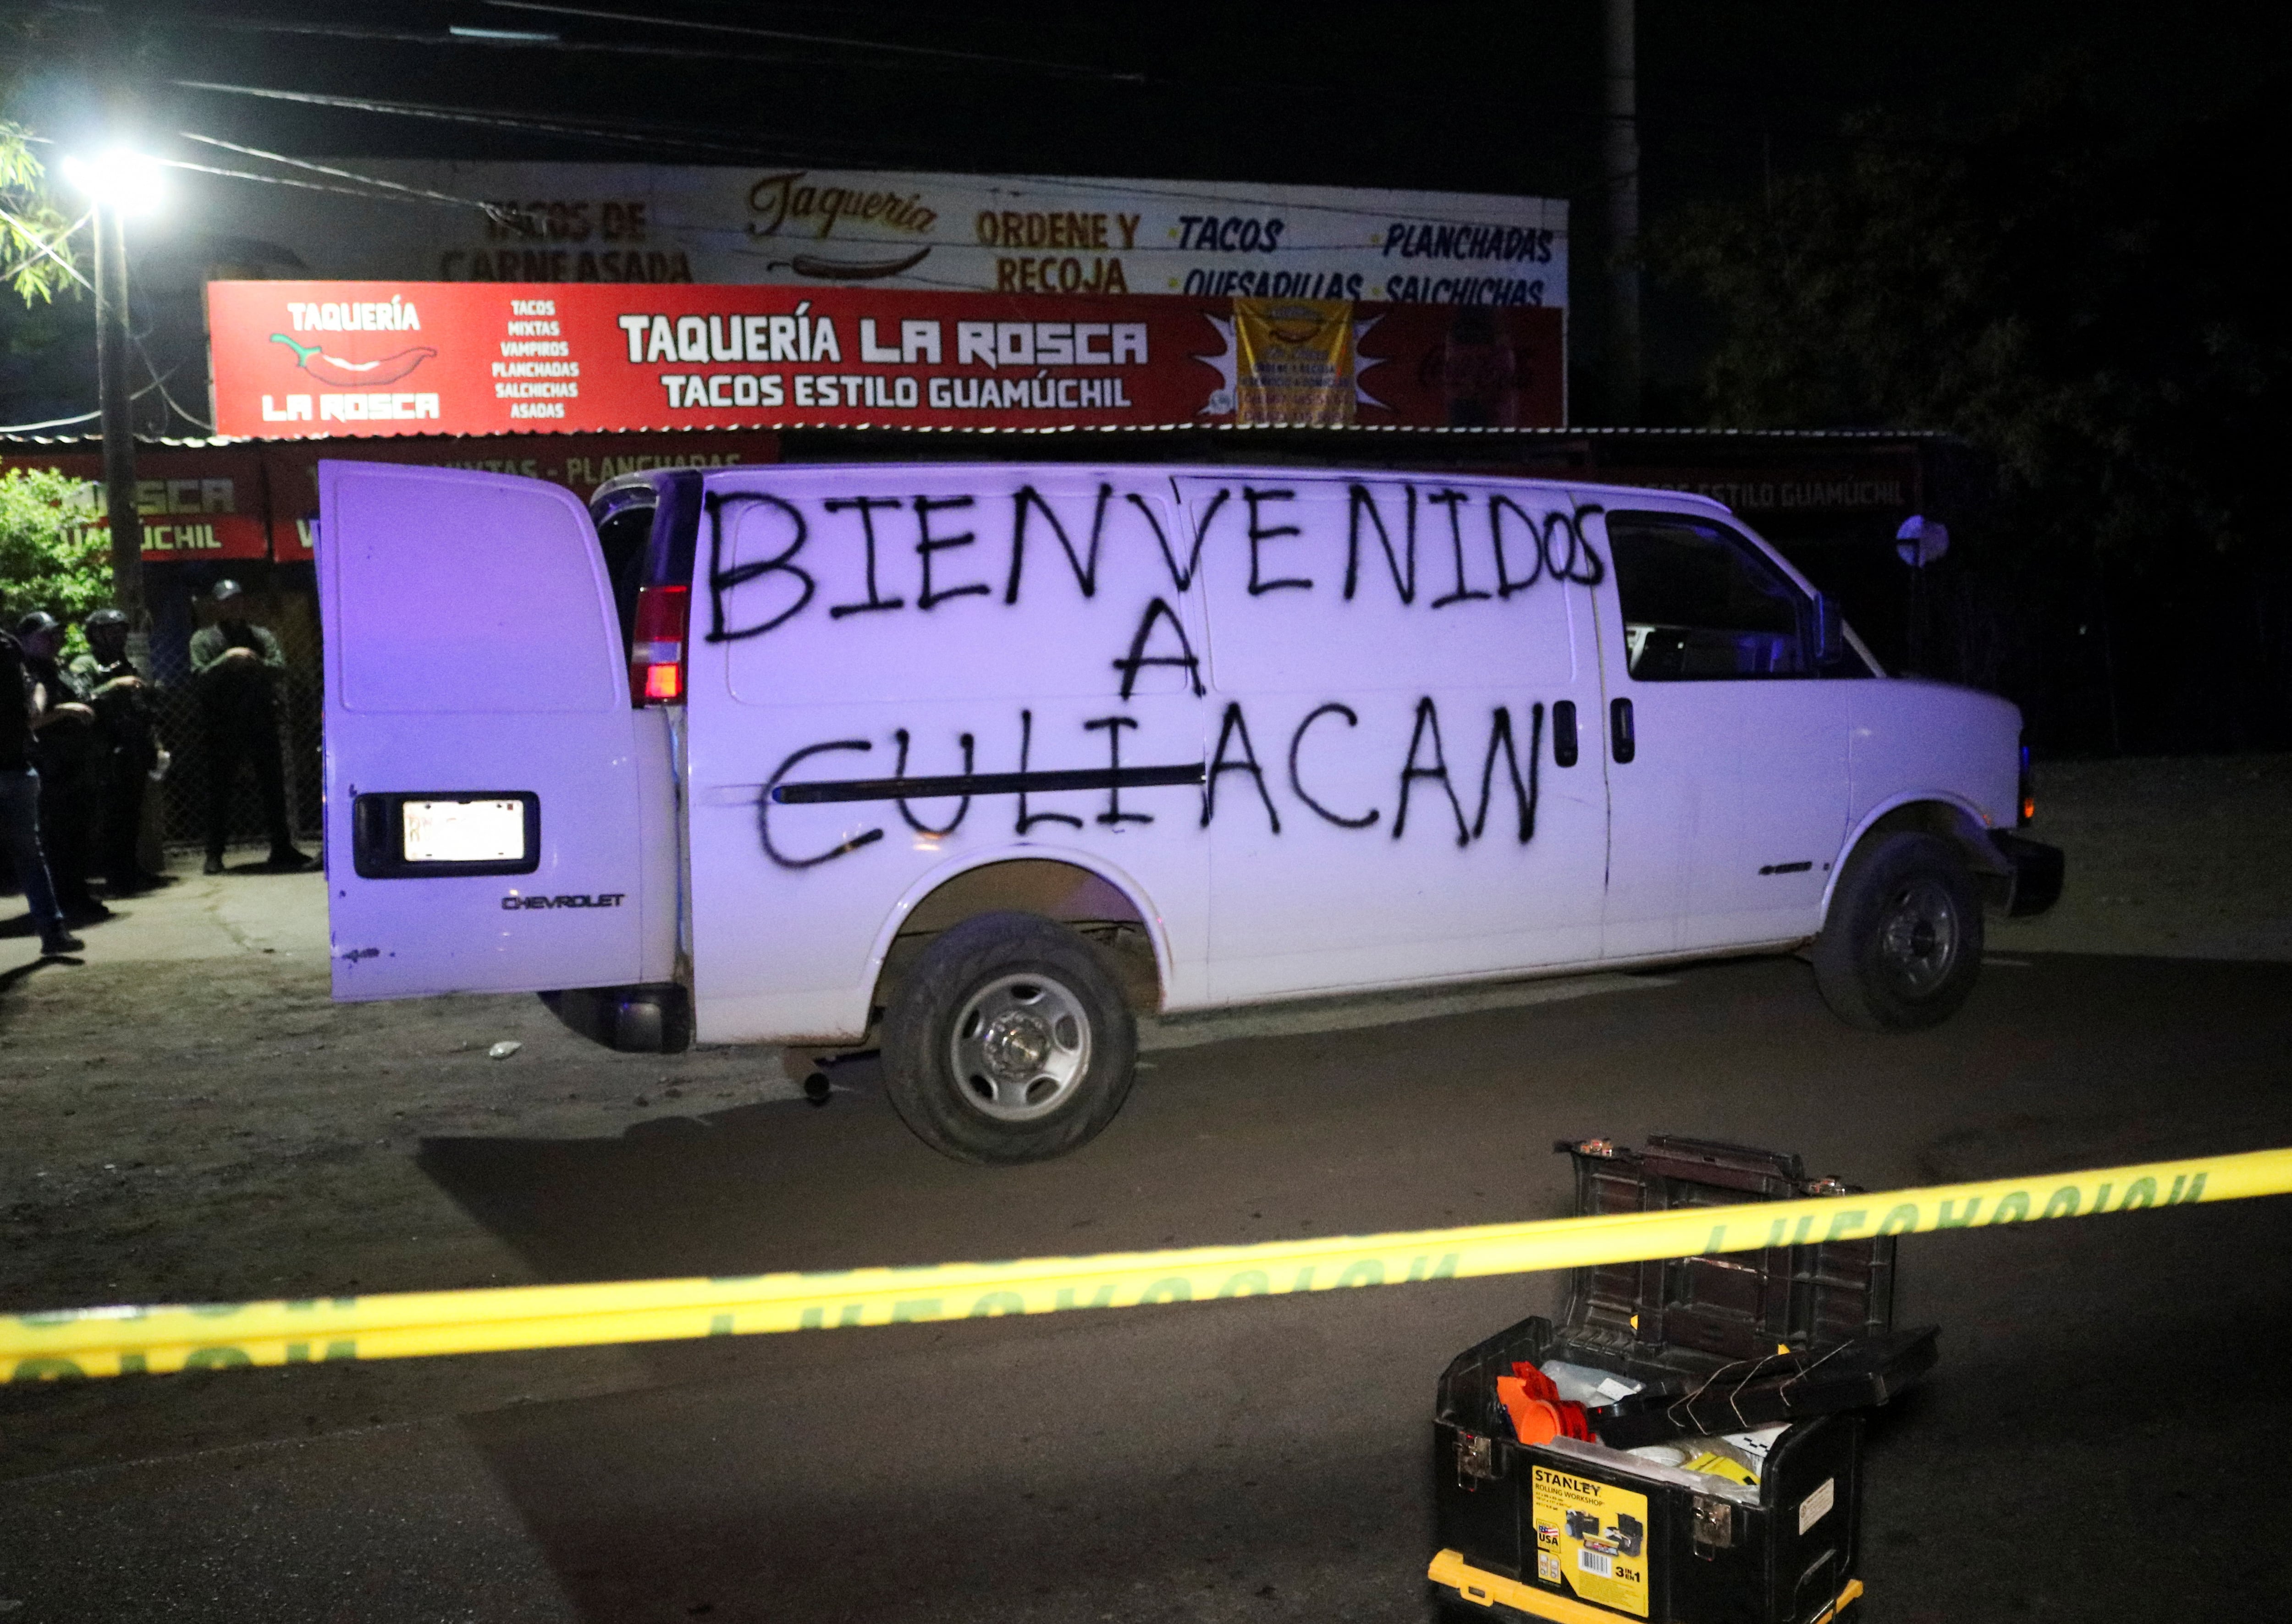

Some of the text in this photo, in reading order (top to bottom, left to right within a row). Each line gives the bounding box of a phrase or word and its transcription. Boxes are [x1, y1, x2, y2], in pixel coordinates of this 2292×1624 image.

[603, 202, 646, 242] DE
[977, 209, 1141, 249] ORDENE Y
[1179, 216, 1284, 253] TACOS
[1383, 223, 1554, 264] PLANCHADAS
[996, 257, 1129, 294] RECOJA
[287, 294, 420, 331] TAQUERÍA
[511, 299, 555, 316] TACOS
[507, 320, 560, 337] MIXTAS
[618, 301, 1149, 370] TAQUERÍA LA ROSCA
[500, 341, 569, 357] VAMPIROS
[492, 362, 579, 378] PLANCHADAS
[495, 381, 578, 398] SALCHICHAS
[661, 370, 1132, 409] TACOS ESTILO GUAMÚCHIL
[261, 392, 440, 423] LA ROSCA
[510, 402, 564, 419] ASADAS
[704, 484, 1607, 644] BIENVENIDOS
[1112, 597, 1206, 700] A
[757, 694, 1543, 870] CULIACAN
[501, 894, 625, 910] CHEVROLET
[1535, 1470, 1601, 1497] STANLEY
[1535, 1483, 1563, 1497] ROLLING
[1564, 1491, 1603, 1507] WORKSHOP
[1539, 1533, 1559, 1546] USA
[1615, 1566, 1624, 1577] 3
[1634, 1572, 1640, 1583] 1
